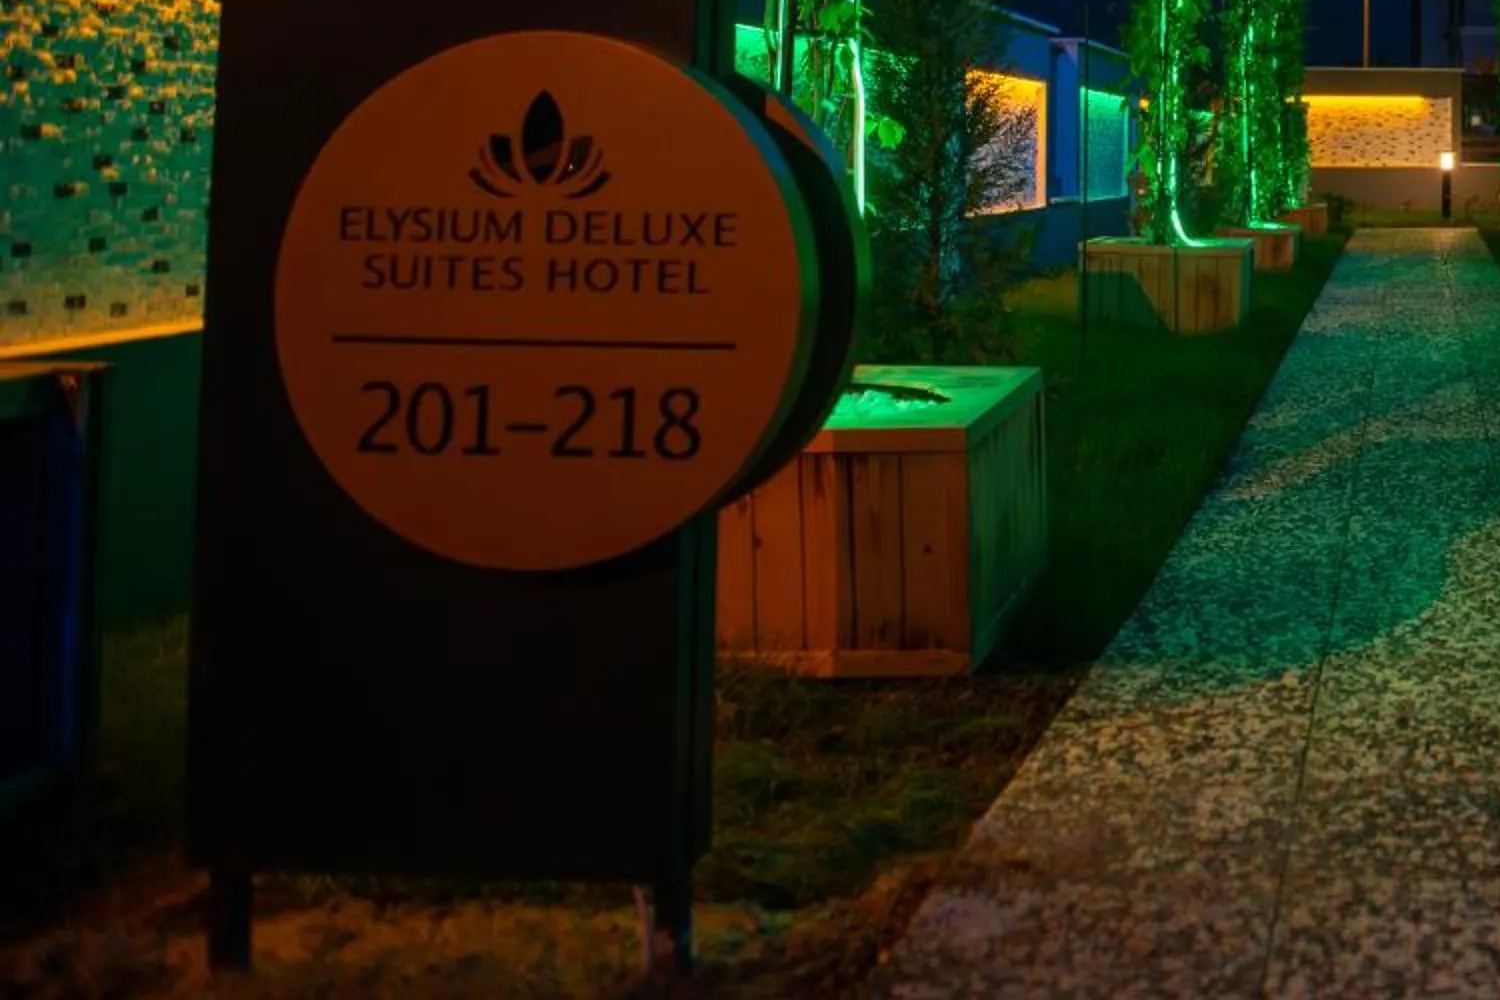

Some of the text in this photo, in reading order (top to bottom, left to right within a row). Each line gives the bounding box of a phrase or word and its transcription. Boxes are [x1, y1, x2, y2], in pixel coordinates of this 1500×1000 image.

[339, 205, 740, 248] ELYSIUM DELUXE
[361, 253, 709, 296] SUITES HOTEL
